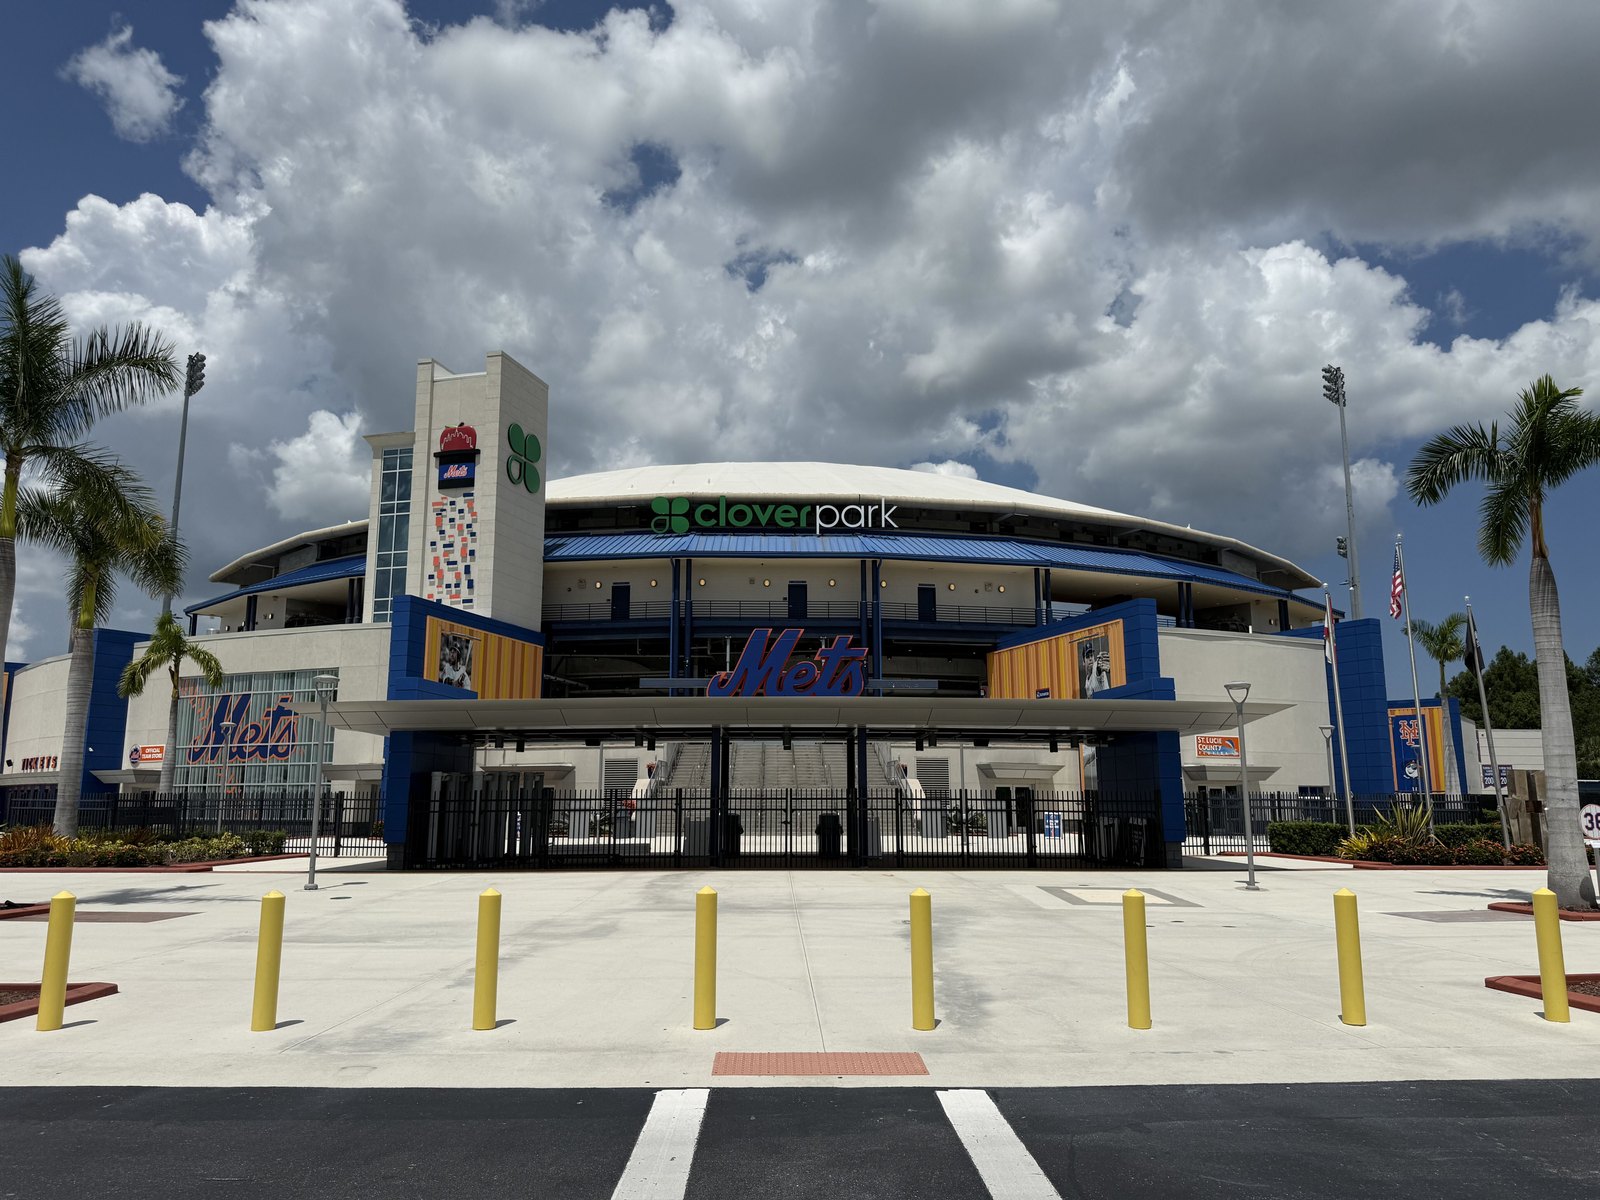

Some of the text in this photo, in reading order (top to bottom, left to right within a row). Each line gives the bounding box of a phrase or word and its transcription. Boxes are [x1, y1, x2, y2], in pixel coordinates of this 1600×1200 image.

[443, 464, 468, 479] Mets
[706, 628, 869, 698] Mets
[186, 692, 301, 765] Mets
[1198, 743, 1222, 751] COUNTY
[21, 755, 59, 771] TICKETS
[1484, 776, 1495, 785] 200
